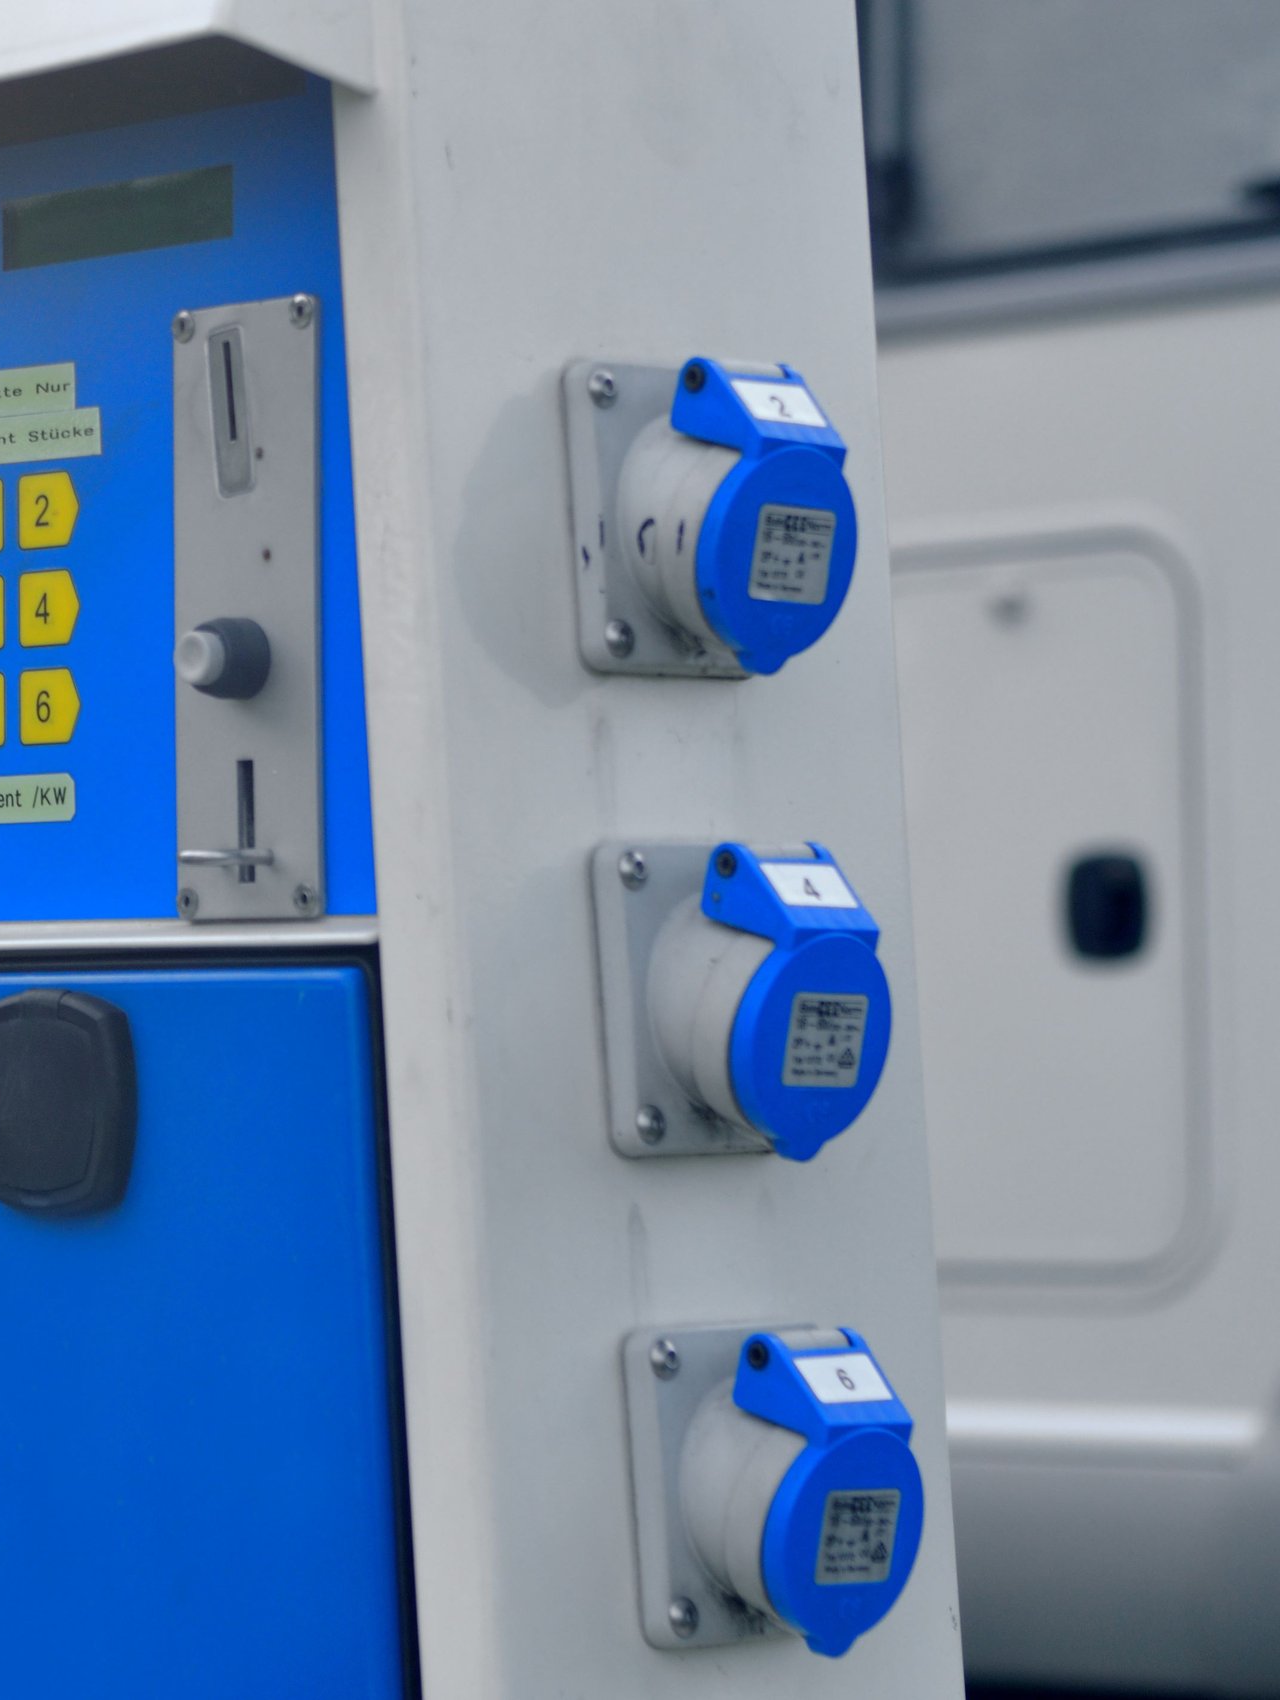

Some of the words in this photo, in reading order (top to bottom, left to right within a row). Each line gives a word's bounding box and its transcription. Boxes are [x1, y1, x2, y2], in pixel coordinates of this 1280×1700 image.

[35, 382, 71, 394] Nur
[770, 396, 791, 417] 2
[28, 425, 95, 443] Stücke
[34, 494, 50, 528] 2
[34, 592, 51, 625] 4
[35, 689, 51, 724] 6
[32, 785, 67, 809] /KW
[803, 878, 821, 898] 4
[836, 1368, 855, 1391] 6
